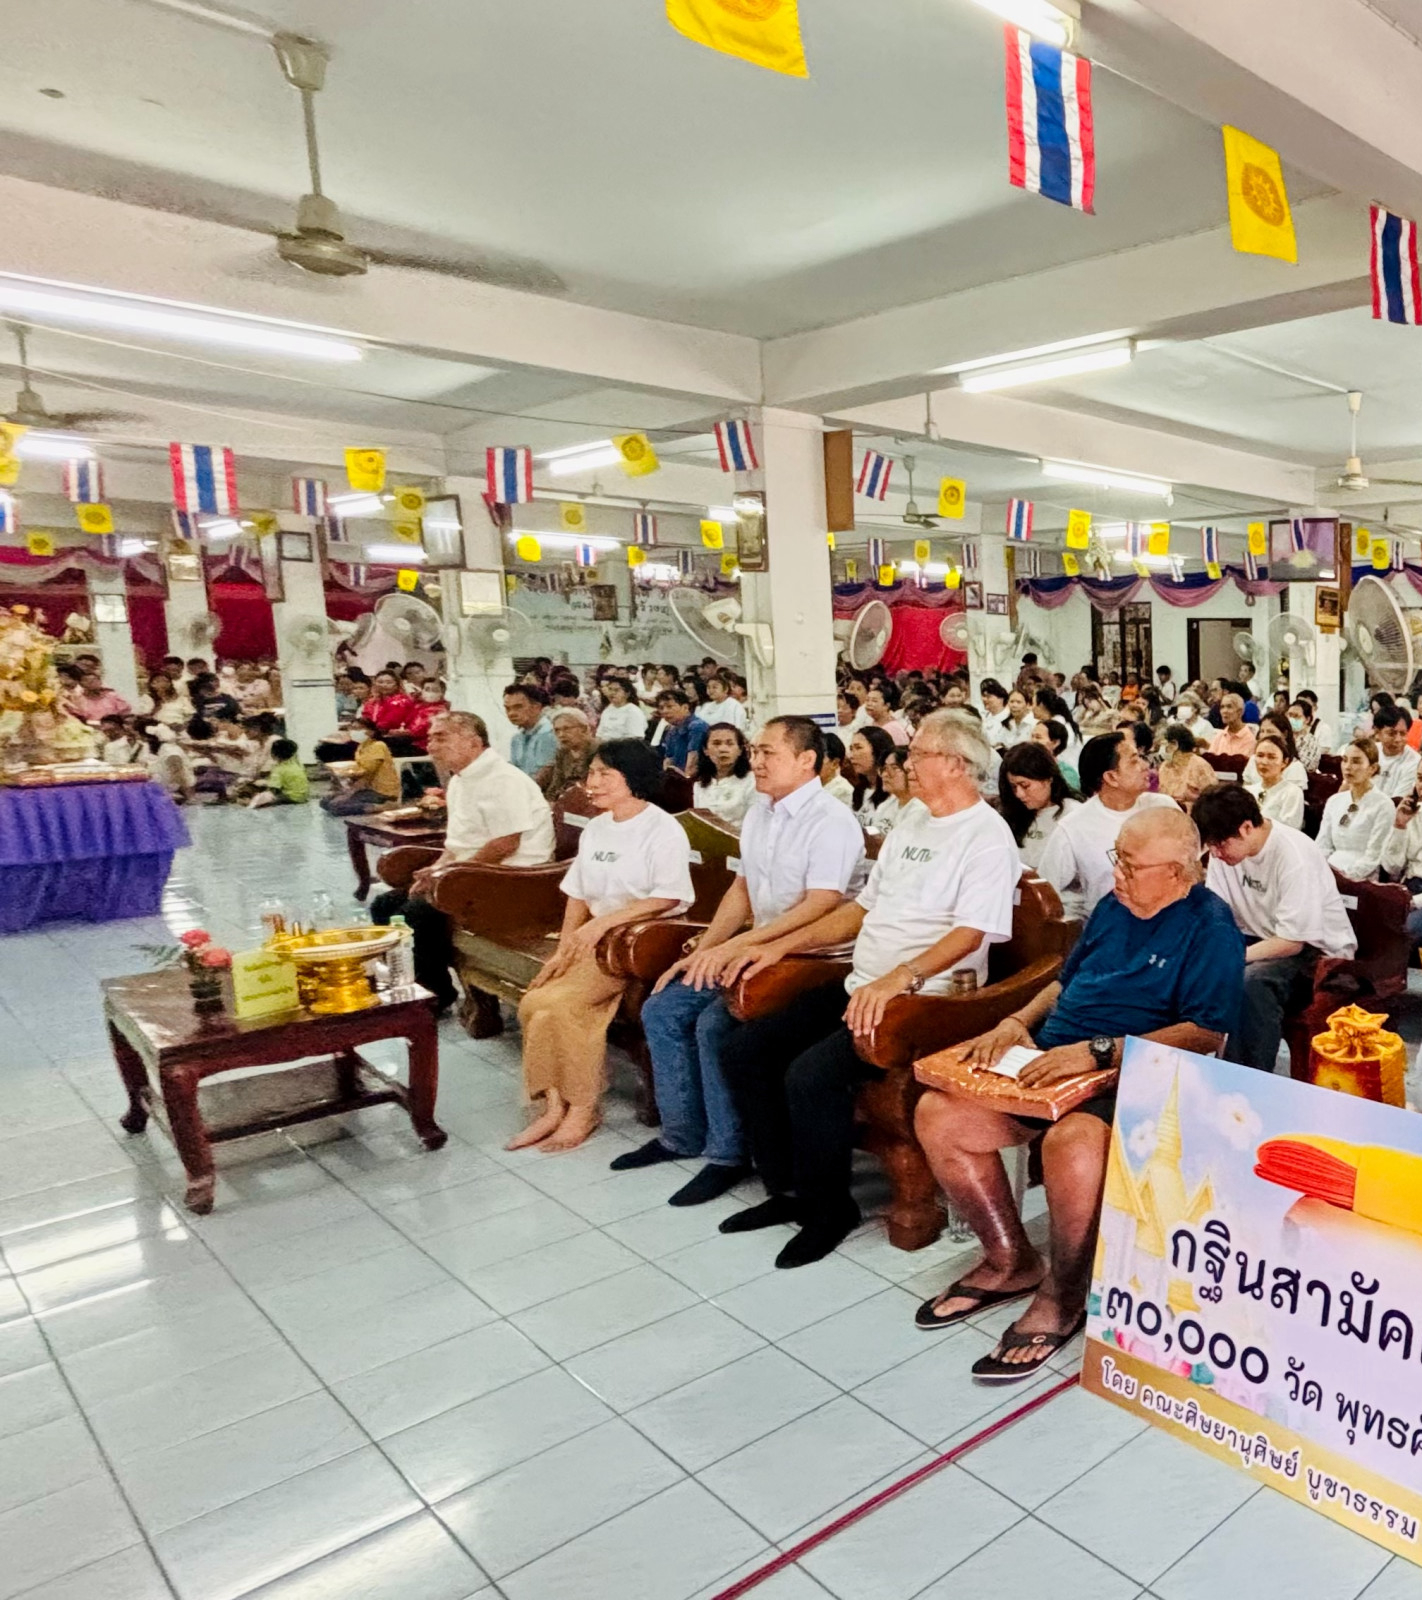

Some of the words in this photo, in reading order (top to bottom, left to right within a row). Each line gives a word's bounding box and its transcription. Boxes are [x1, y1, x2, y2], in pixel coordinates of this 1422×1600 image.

[1106, 1287, 1269, 1384] ๓๐,๐๐๐
[1285, 1356, 1323, 1411] วัด
[1103, 1360, 1136, 1396] โดย
[1142, 1388, 1299, 1478] คณะศิษยานุศิษย์
[1307, 1468, 1417, 1539] บูชาธรรม
